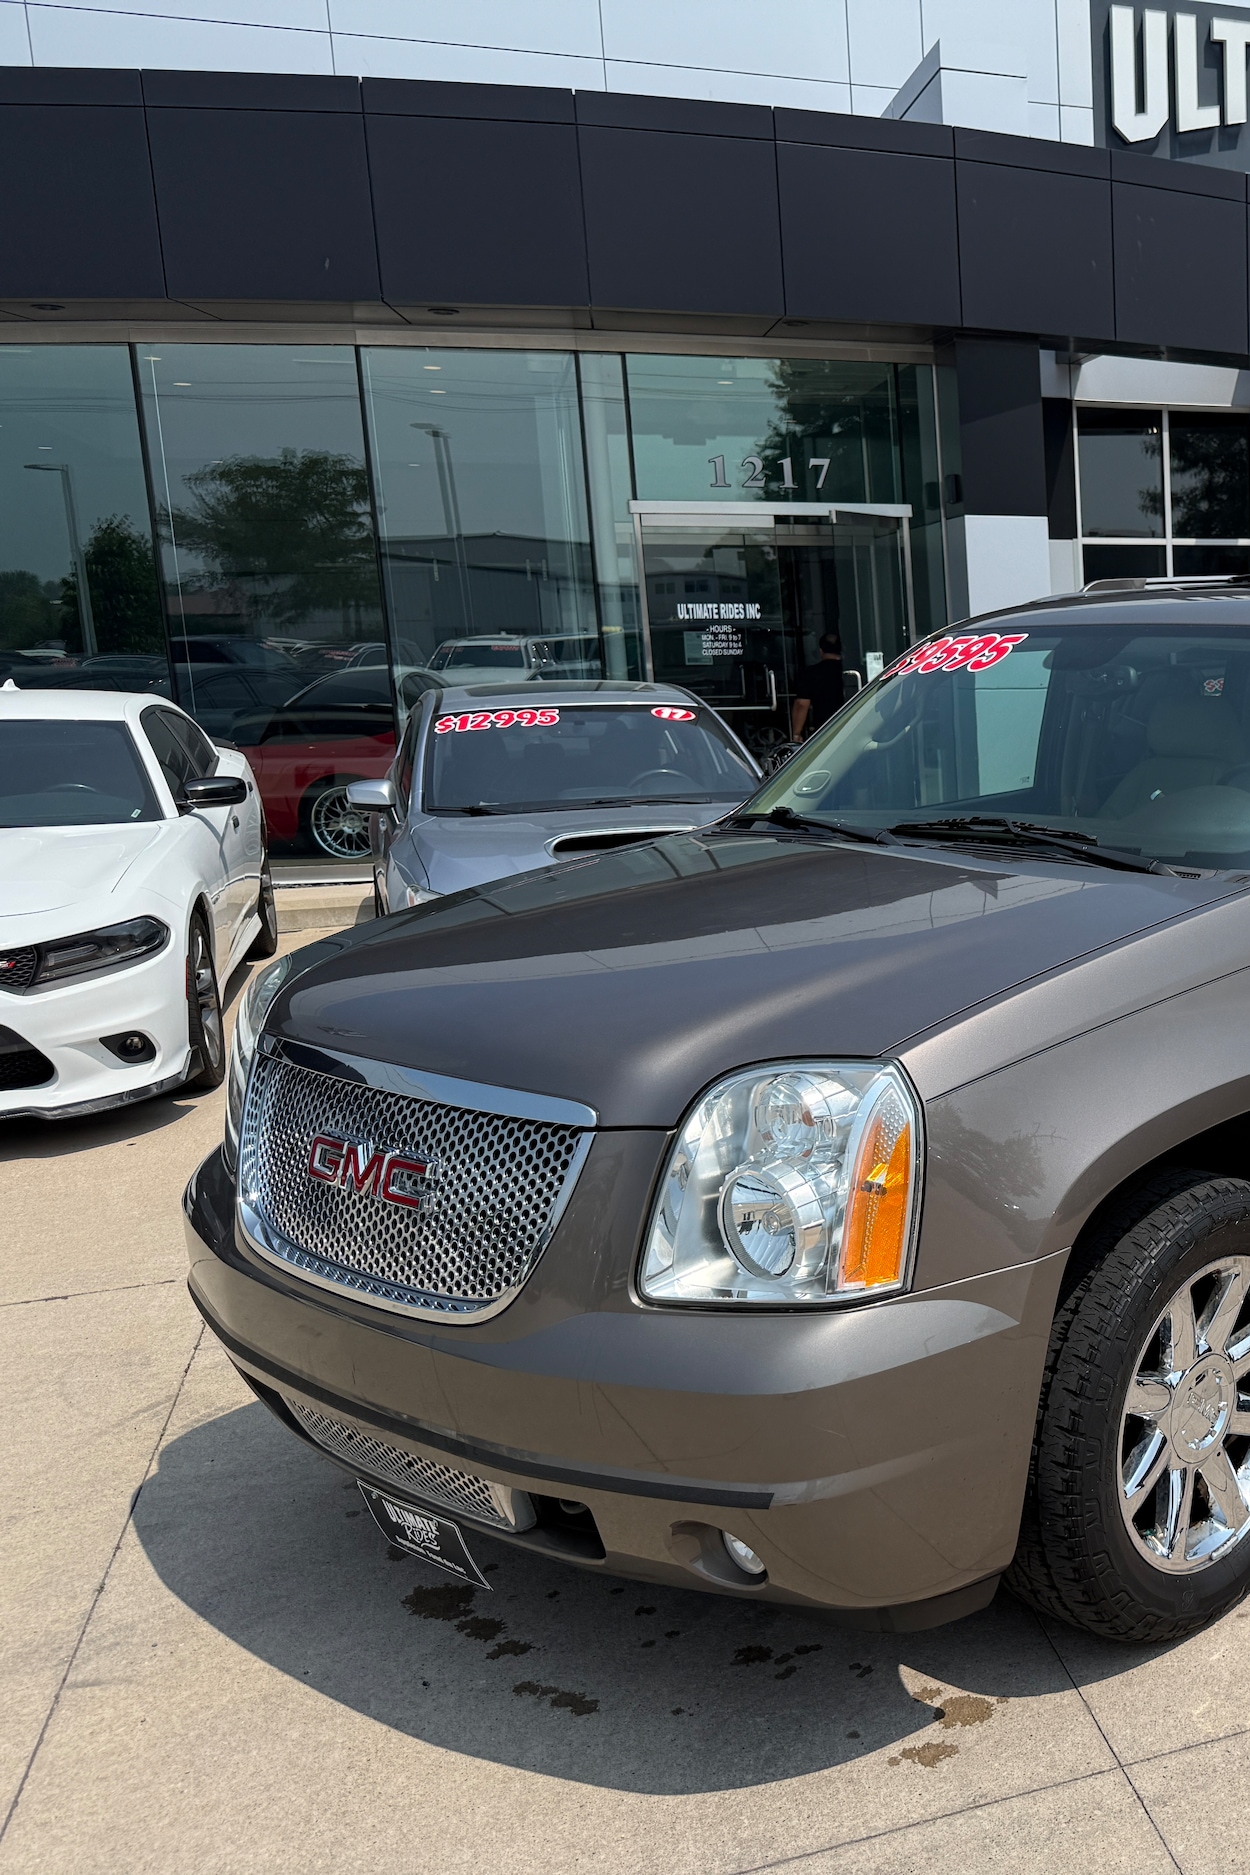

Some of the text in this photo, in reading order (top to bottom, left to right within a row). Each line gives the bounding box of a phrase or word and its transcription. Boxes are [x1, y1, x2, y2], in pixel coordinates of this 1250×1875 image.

[708, 454, 831, 489] 1217
[677, 603, 761, 619] ULTIMATE RIDES INC
[434, 709, 560, 734] $12995
[308, 1133, 435, 1212] GMC
[382, 1499, 440, 1536] ULTIMATE
